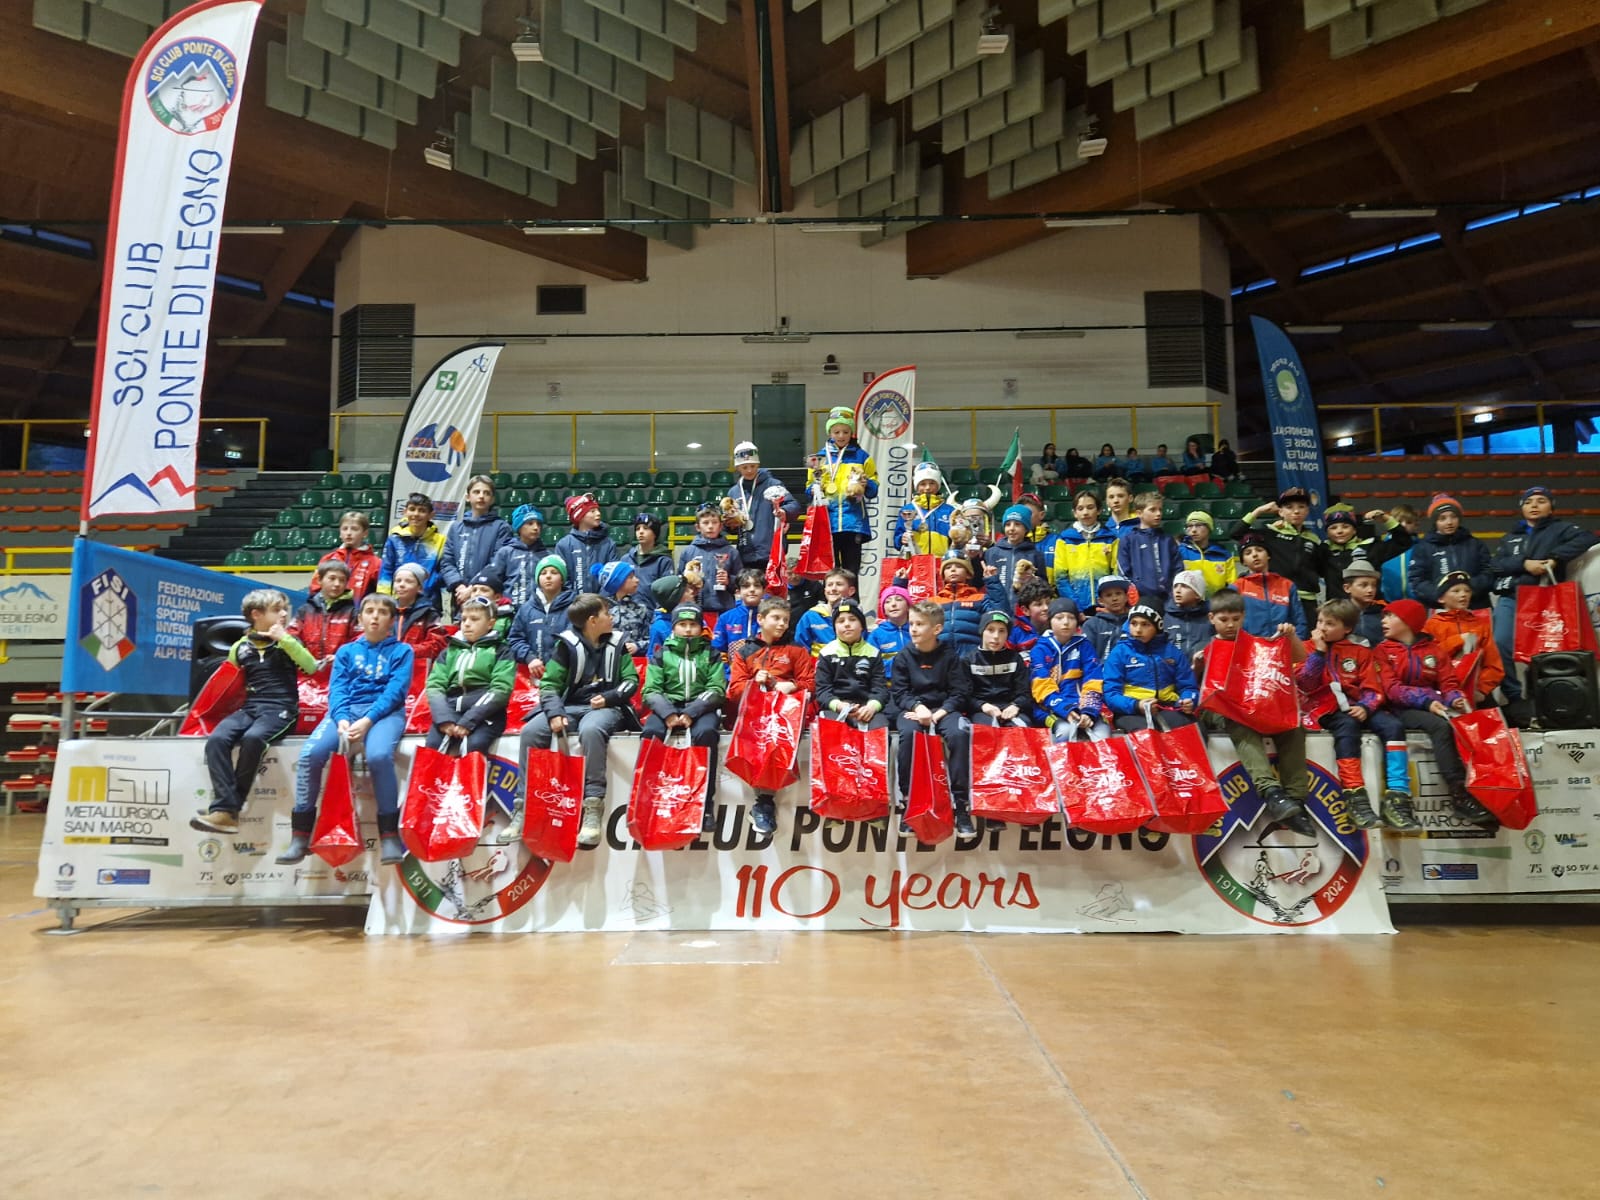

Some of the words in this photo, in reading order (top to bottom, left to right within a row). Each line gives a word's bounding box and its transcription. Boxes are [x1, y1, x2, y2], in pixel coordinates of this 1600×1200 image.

[150, 65, 166, 82] SCI
[158, 46, 183, 67] CLUB
[183, 42, 215, 57] PONTE
[174, 149, 223, 270] LEGNO
[168, 285, 207, 315] DI
[113, 350, 148, 407] SCI
[154, 329, 200, 449] PONTE
[887, 446, 909, 507] LEGNO
[91, 574, 129, 601] FISI
[157, 580, 225, 605] FEDERAZIONE
[156, 607, 191, 623] SPORT
[157, 594, 201, 613] ITALIANA
[155, 634, 193, 648] COMITAT
[156, 621, 193, 636] INVERN
[153, 647, 177, 659] ALPI
[179, 649, 193, 661] CE
[254, 787, 277, 796] sara
[1568, 776, 1591, 785] sara
[65, 806, 169, 821] METALLURGICA
[1223, 774, 1249, 805] LUB
[1315, 783, 1356, 835] LEGNO
[64, 821, 95, 834] SAN
[100, 822, 153, 835] MARCO
[408, 870, 433, 899] 1911
[507, 875, 535, 901] 2021
[736, 865, 841, 919] 110
[859, 870, 1040, 928] years
[1214, 873, 1243, 901] 1911
[1322, 875, 1348, 903] 2021
